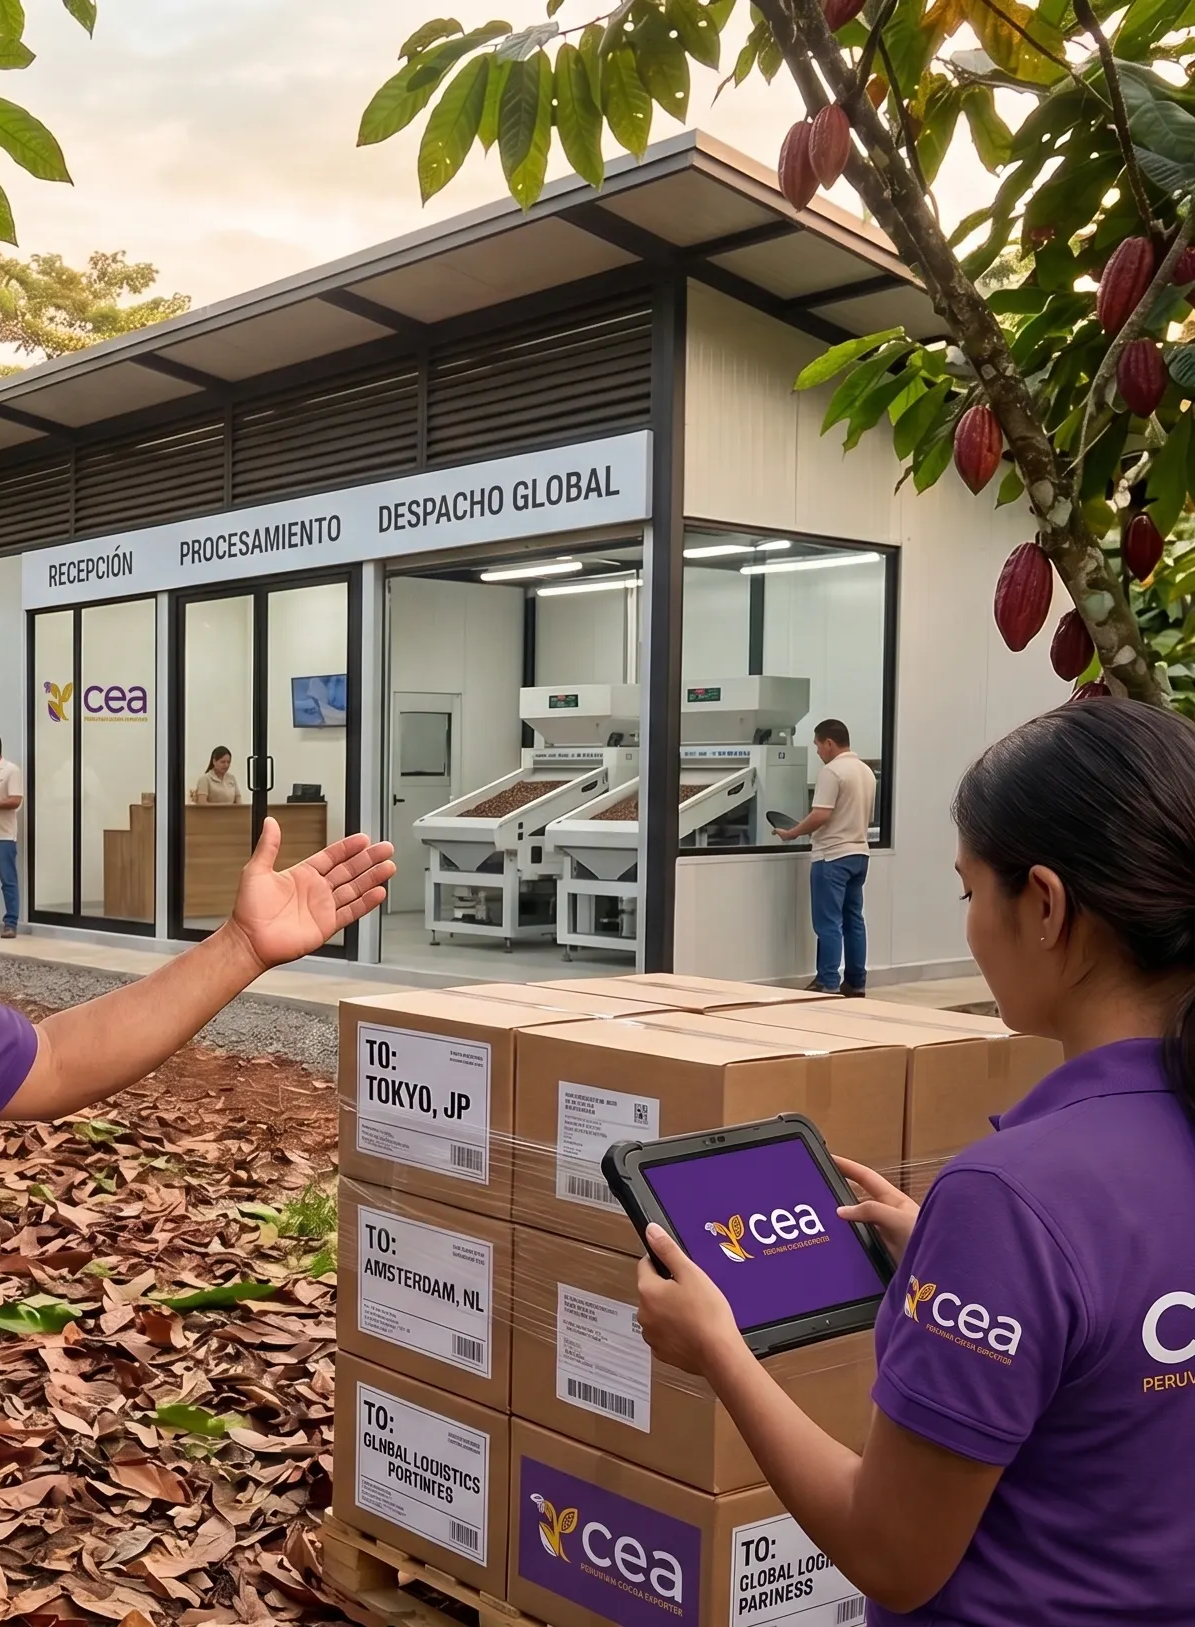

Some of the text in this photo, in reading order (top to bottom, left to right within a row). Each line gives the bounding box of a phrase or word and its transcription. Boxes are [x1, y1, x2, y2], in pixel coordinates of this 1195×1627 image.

[378, 465, 620, 534] DESPACHO GLOBAL
[179, 514, 341, 567] PROCESAMIENTO
[48, 544, 133, 588] RECEPCIÓN
[83, 685, 147, 714] cea
[365, 1038, 397, 1071] TO:
[365, 1074, 471, 1120] TOKYO, JP
[365, 1223, 397, 1256] TO:
[748, 1203, 825, 1245] cea
[364, 1257, 485, 1313] AMSTERDAM, NL
[932, 1292, 1022, 1356] cea
[363, 1399, 394, 1434] TO:
[581, 1521, 683, 1604] cea
[741, 1535, 777, 1567] TO:
[738, 1577, 814, 1616] PARINESS
[739, 1562, 794, 1593] GLOBAL
